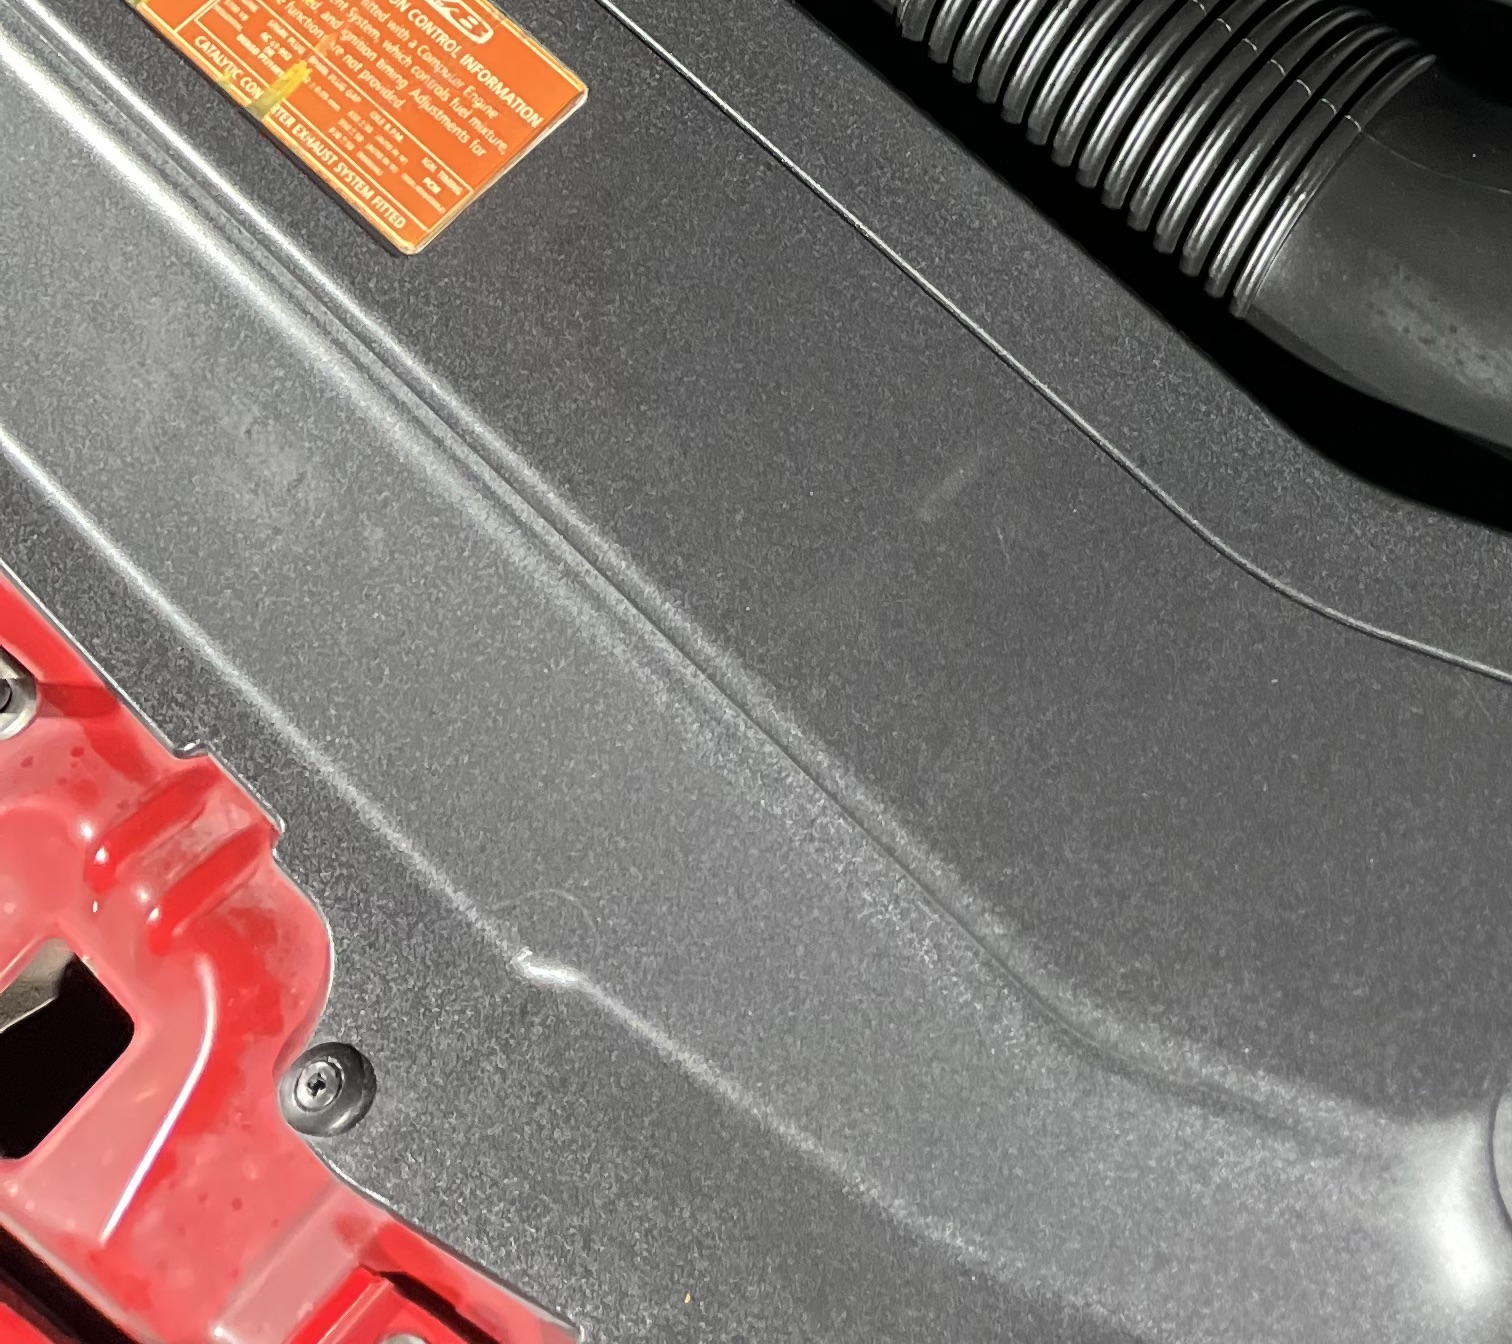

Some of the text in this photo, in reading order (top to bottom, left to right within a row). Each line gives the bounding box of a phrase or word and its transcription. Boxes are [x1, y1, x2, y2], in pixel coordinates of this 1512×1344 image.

[320, 9, 344, 30] and
[405, 86, 473, 145] Adjustments
[467, 138, 489, 158] for
[341, 53, 363, 72] not
[380, 37, 415, 67] which
[409, 63, 453, 102] controls
[448, 97, 473, 119] fuel
[385, 18, 412, 41] with
[406, 38, 418, 49] a
[413, 44, 467, 91] Computer
[460, 85, 501, 121] Engine
[405, 7, 464, 58] CONTROL
[457, 53, 544, 127] INFORMATION
[193, 34, 243, 80] CATALYTIC
[290, 122, 338, 167] EXHAUST
[333, 161, 375, 200] SYSTEM
[370, 195, 407, 230] FITTED
